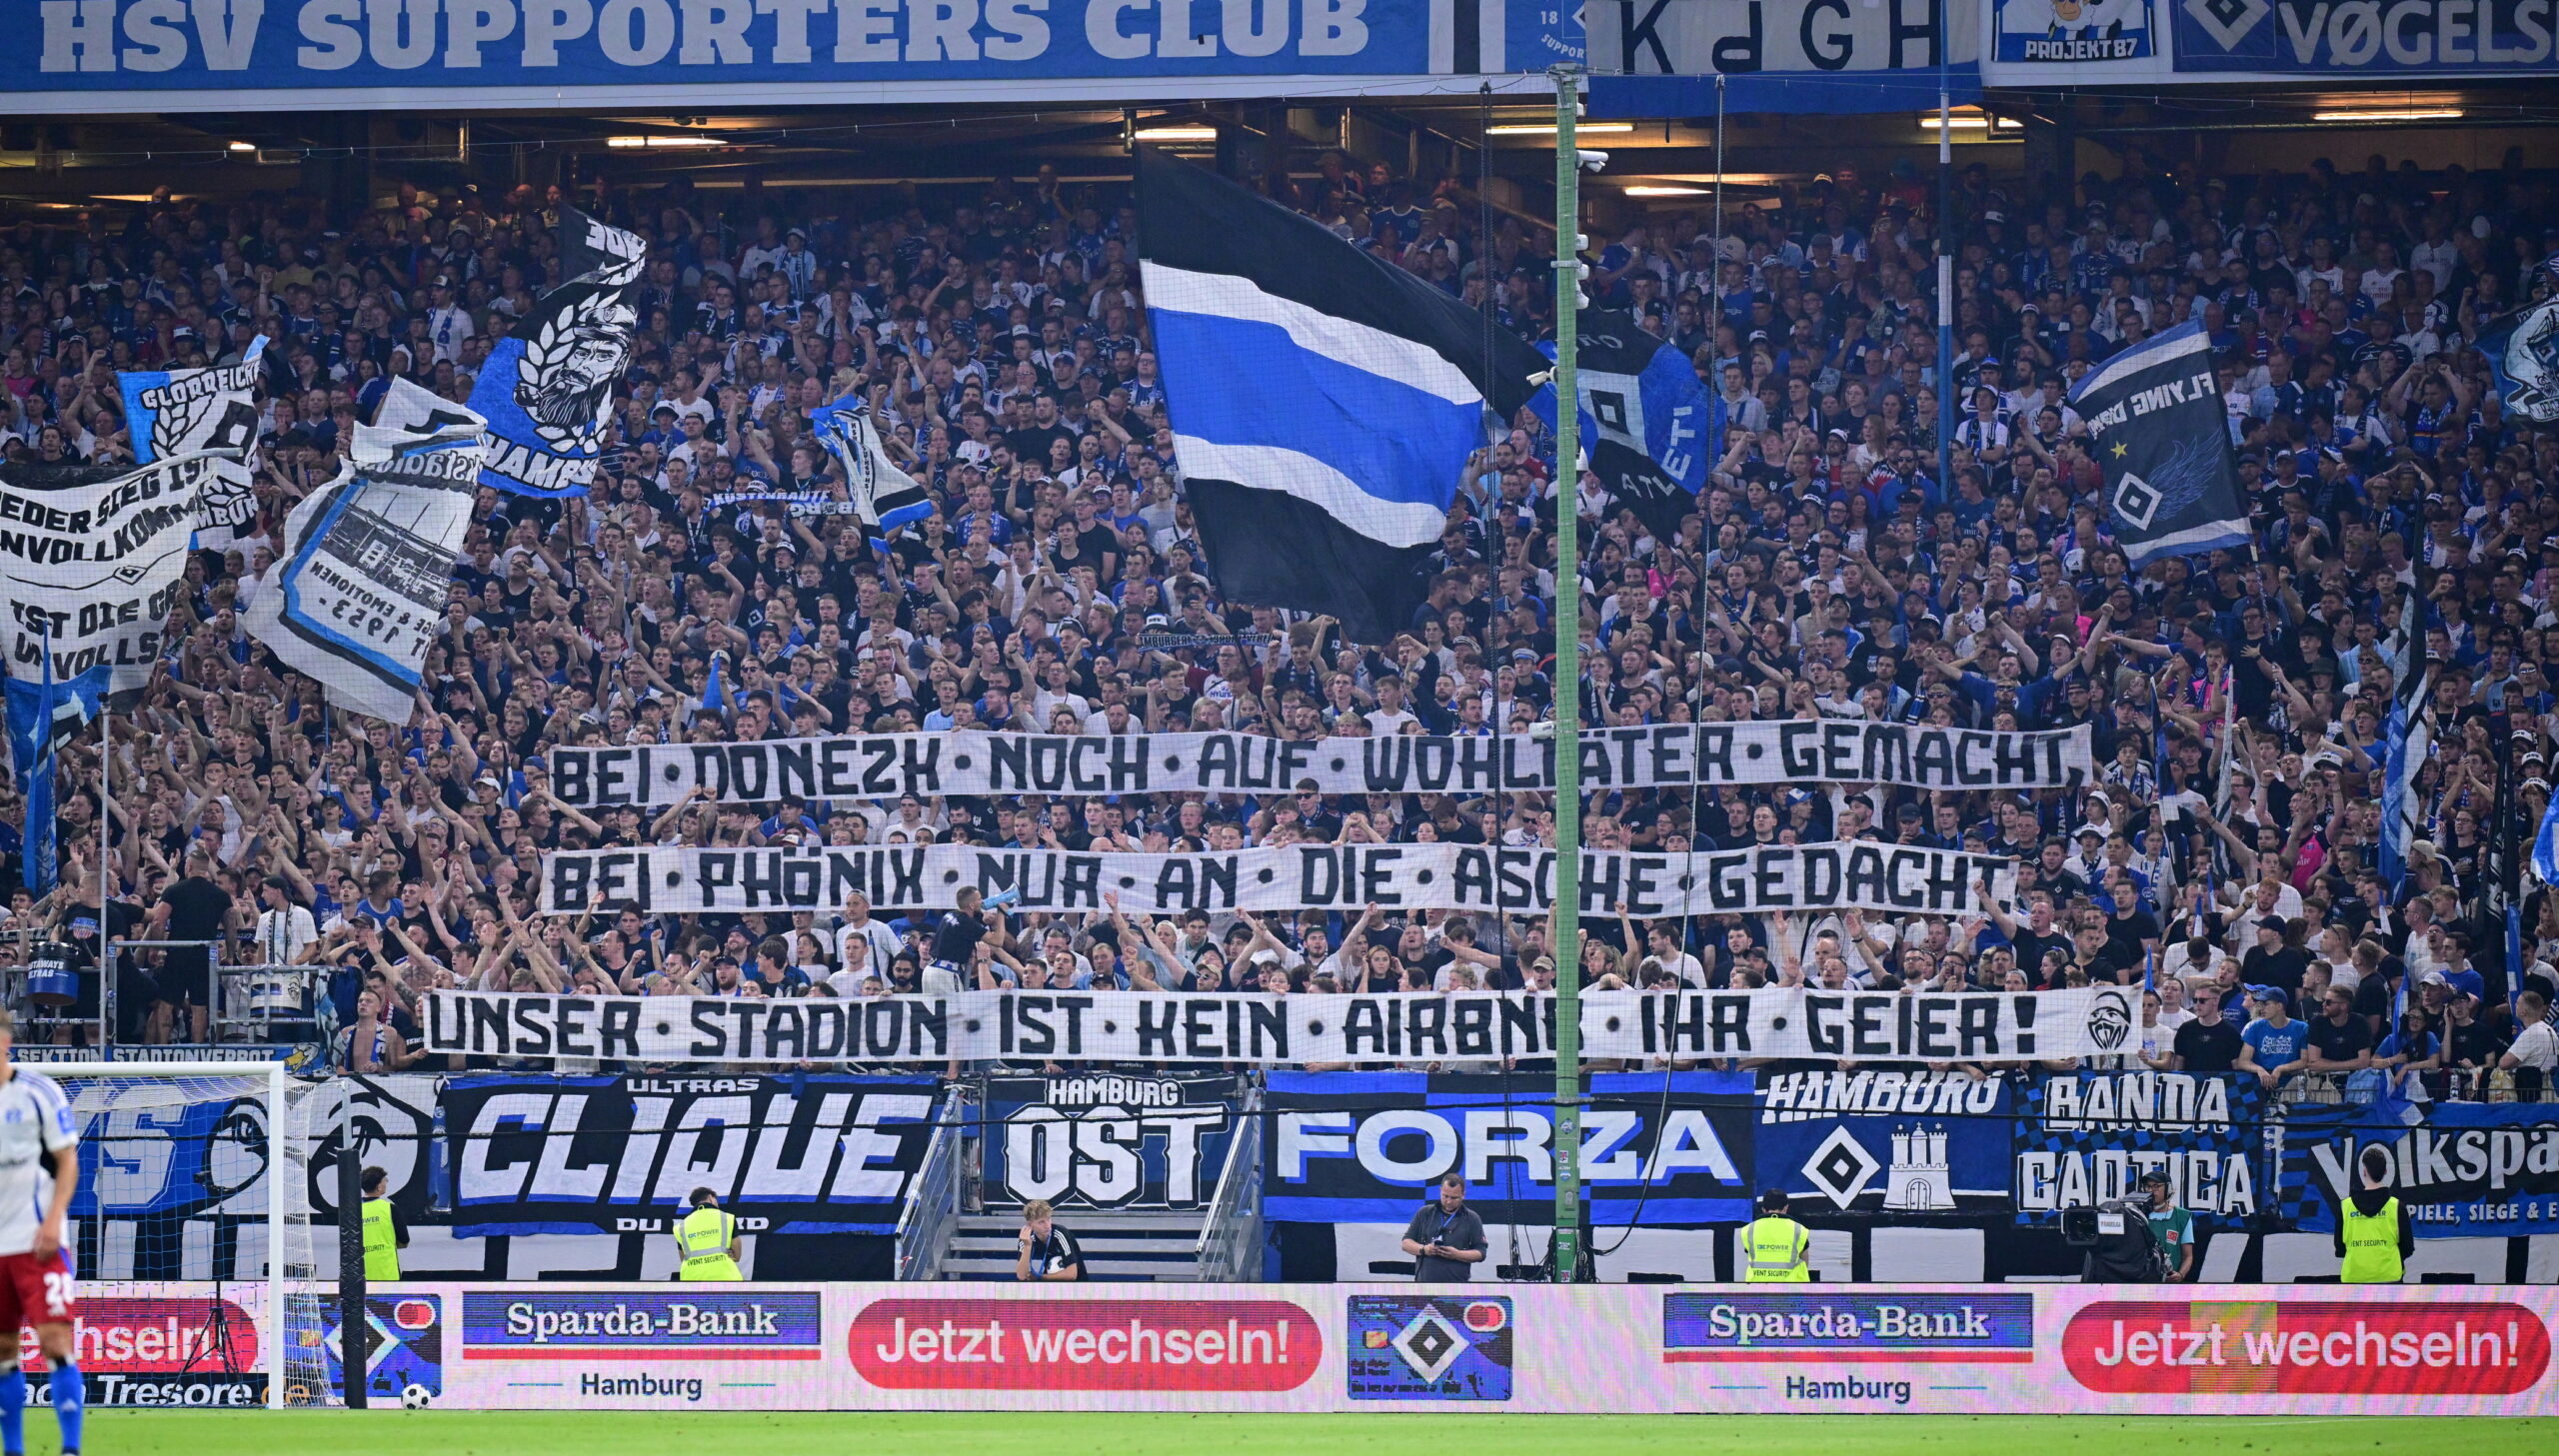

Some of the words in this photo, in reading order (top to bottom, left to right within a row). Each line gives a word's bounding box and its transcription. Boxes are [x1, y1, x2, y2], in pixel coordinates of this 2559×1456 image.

[40, 0, 263, 72] HSV
[297, 0, 1052, 68] SUPPORTERS
[1085, 0, 1369, 59] CLUB
[2278, 0, 2559, 65] VØGELS
[0, 491, 91, 534] EDER
[95, 468, 161, 528] SIEG
[10, 598, 71, 640] IST
[79, 598, 140, 639] DIE
[551, 746, 651, 804] BEI
[989, 735, 1151, 791] NOCH
[1196, 734, 1317, 791] AUF
[1362, 727, 1734, 792] WOHLTÄTER
[551, 851, 651, 910] BEI
[696, 846, 925, 909] PHÖNIX
[975, 852, 1102, 909] NUR
[1155, 856, 1239, 909] AN
[1300, 847, 1400, 906] DIE
[1452, 848, 1668, 914] ASCHE
[430, 997, 642, 1057] UNSER
[690, 999, 948, 1058] STADION
[1000, 995, 1094, 1054] IST
[1135, 999, 1289, 1058] KEIN
[1640, 994, 1750, 1053] IHR
[1805, 994, 2035, 1057] GEIER!
[17, 1048, 100, 1062] SEKTION
[113, 1047, 276, 1062] STADIONVERBOT
[626, 1077, 761, 1094] ULTRAS
[1048, 1078, 1180, 1106] HAMBURG
[2044, 1074, 2230, 1132] BANDA
[460, 1092, 934, 1208] CLIQUE
[1007, 1105, 1224, 1201] OST
[1278, 1108, 1739, 1181] FORZA
[616, 1217, 662, 1232] DU
[2469, 1202, 2519, 1222] SIEGE
[2526, 1201, 2540, 1220] &
[507, 1301, 779, 1343] Sparda-Bank
[876, 1317, 1006, 1365] Jetzt
[1021, 1318, 1290, 1365] wechseln!
[1708, 1303, 1991, 1345] Sparda-Bank
[2094, 1319, 2227, 1367] Jetzt
[2241, 1320, 2519, 1367] wechseln!
[581, 1372, 703, 1402] Hamburg
[1785, 1376, 1912, 1404] Hamburg
